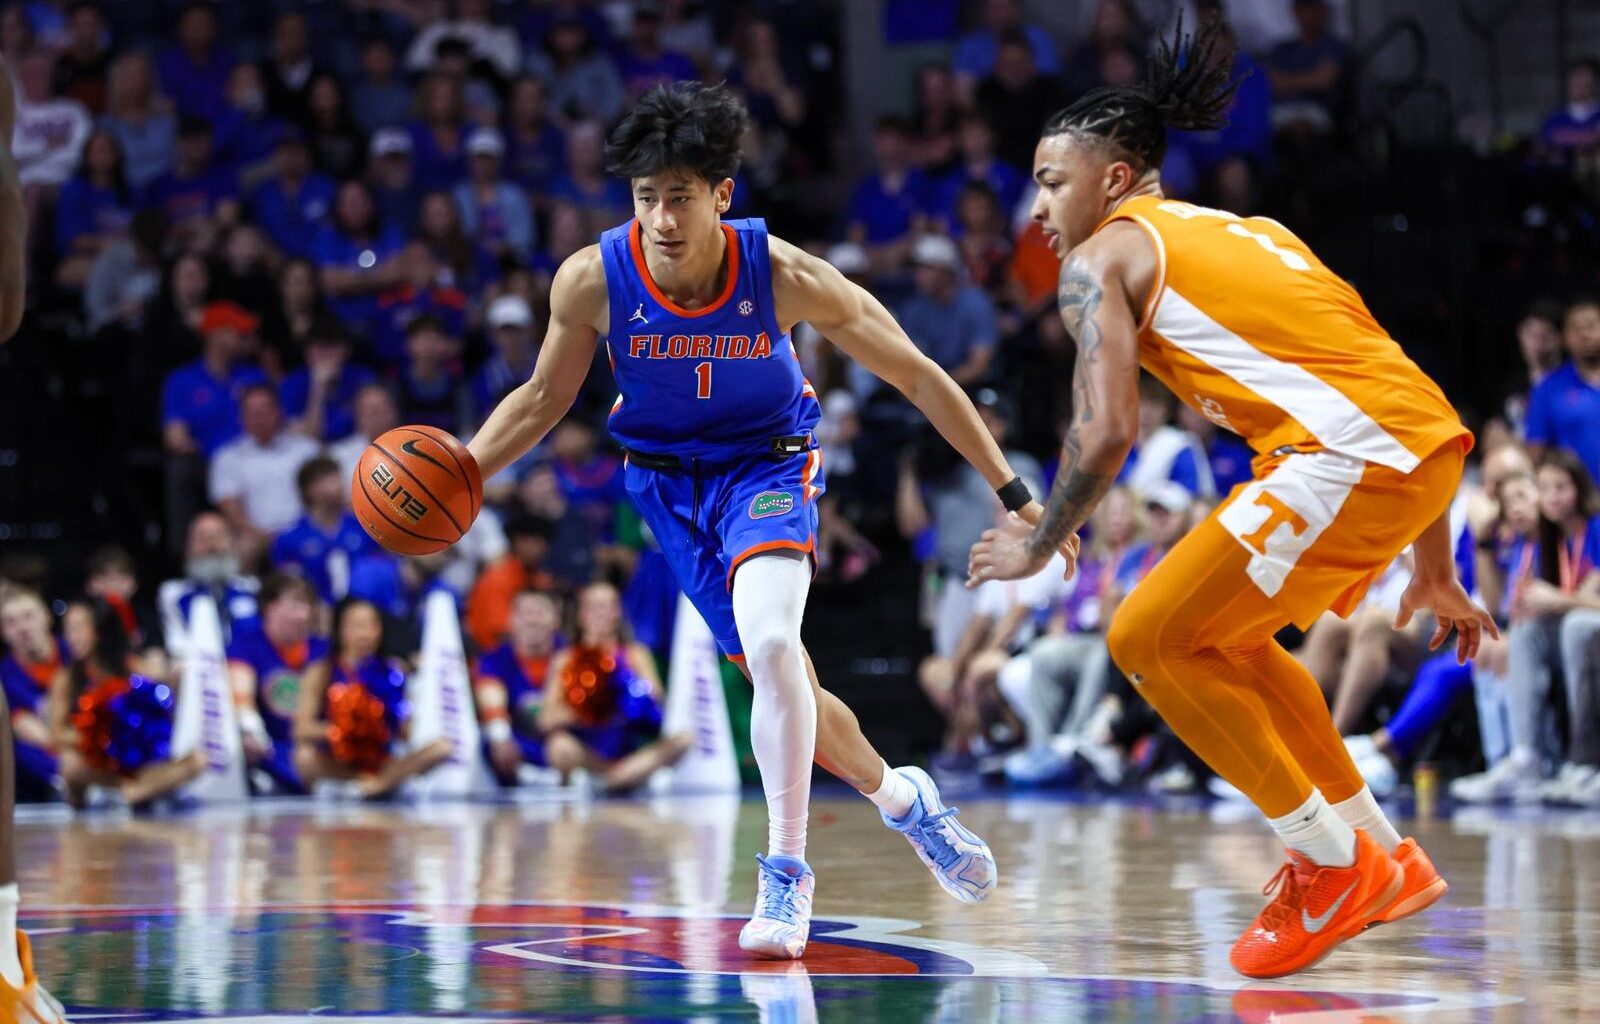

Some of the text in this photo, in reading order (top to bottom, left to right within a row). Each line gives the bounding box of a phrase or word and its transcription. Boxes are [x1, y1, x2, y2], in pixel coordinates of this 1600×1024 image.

[739, 300, 754, 315] SEC
[628, 331, 771, 360] FLORIDA
[695, 362, 712, 399] 1
[371, 462, 429, 521] ELITE
[1239, 489, 1310, 557] T
